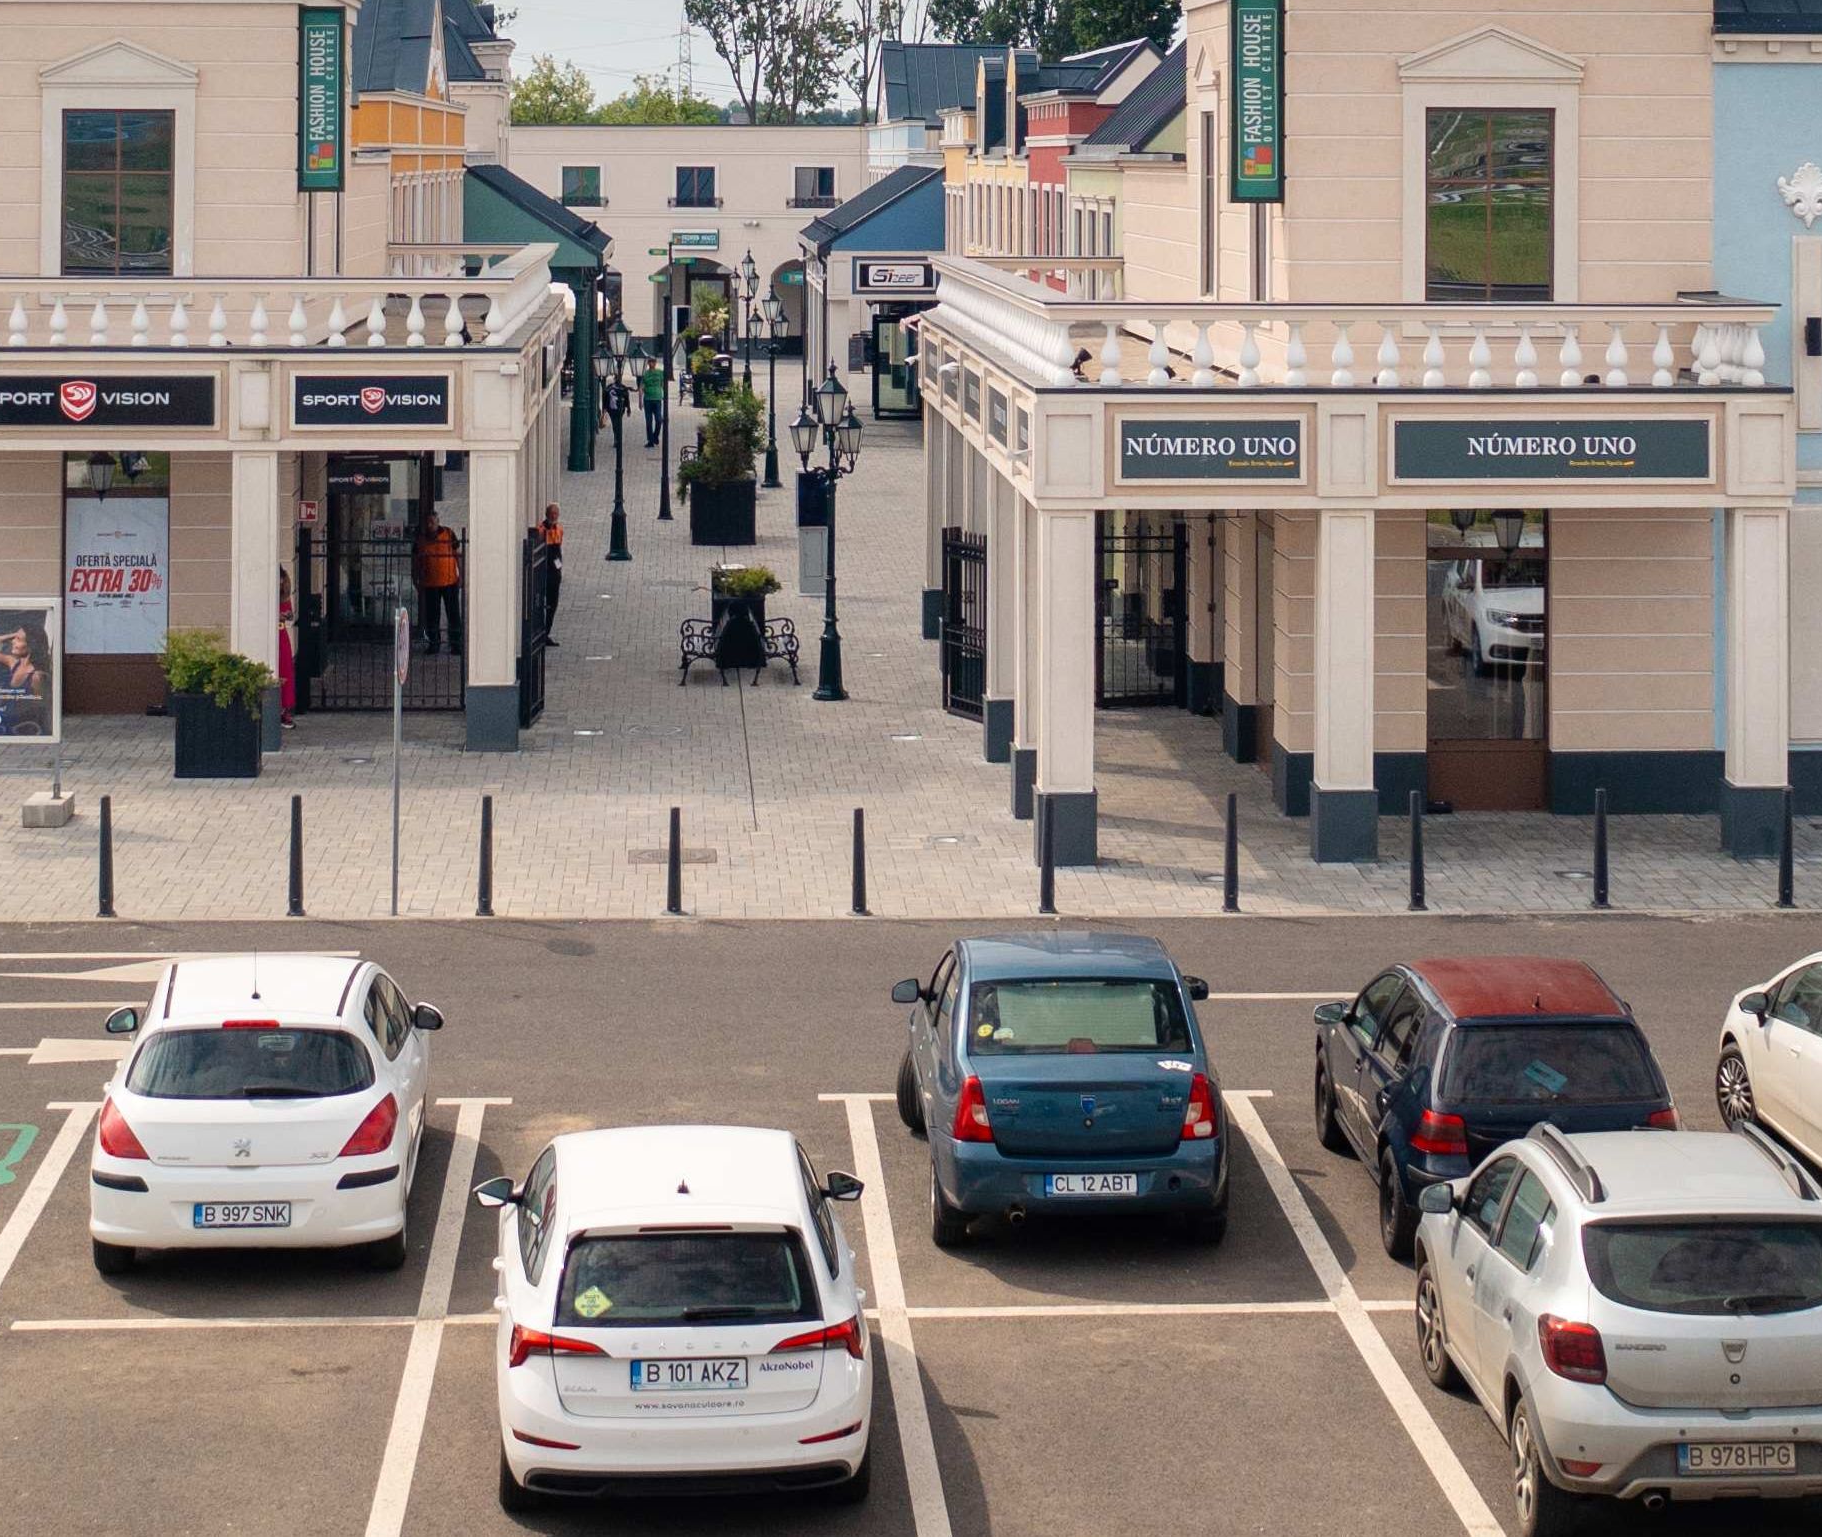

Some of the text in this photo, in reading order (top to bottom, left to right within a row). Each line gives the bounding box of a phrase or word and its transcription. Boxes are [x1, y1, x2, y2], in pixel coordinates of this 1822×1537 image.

[309, 30, 325, 141] FASHION HOUSE
[326, 30, 335, 141] OUTLET CENTRE
[1243, 15, 1261, 143] FASHION HOUSE
[1262, 14, 1273, 143] OUTLET CENTRE
[101, 392, 170, 406] VISION
[302, 393, 441, 406] SPORT VISION
[1126, 433, 1296, 456] NÚMERO UNO
[1467, 432, 1636, 456] NÚMERO UNO
[69, 568, 163, 593] EXTRA 30%
[1055, 1176, 1132, 1192] CL 12 ABT
[205, 1206, 287, 1222] B 997 SNK
[647, 1362, 740, 1383] B 101 AKZ
[759, 1360, 814, 1372] AkzoNobel
[1689, 1445, 1791, 1466] B 978 HPG
